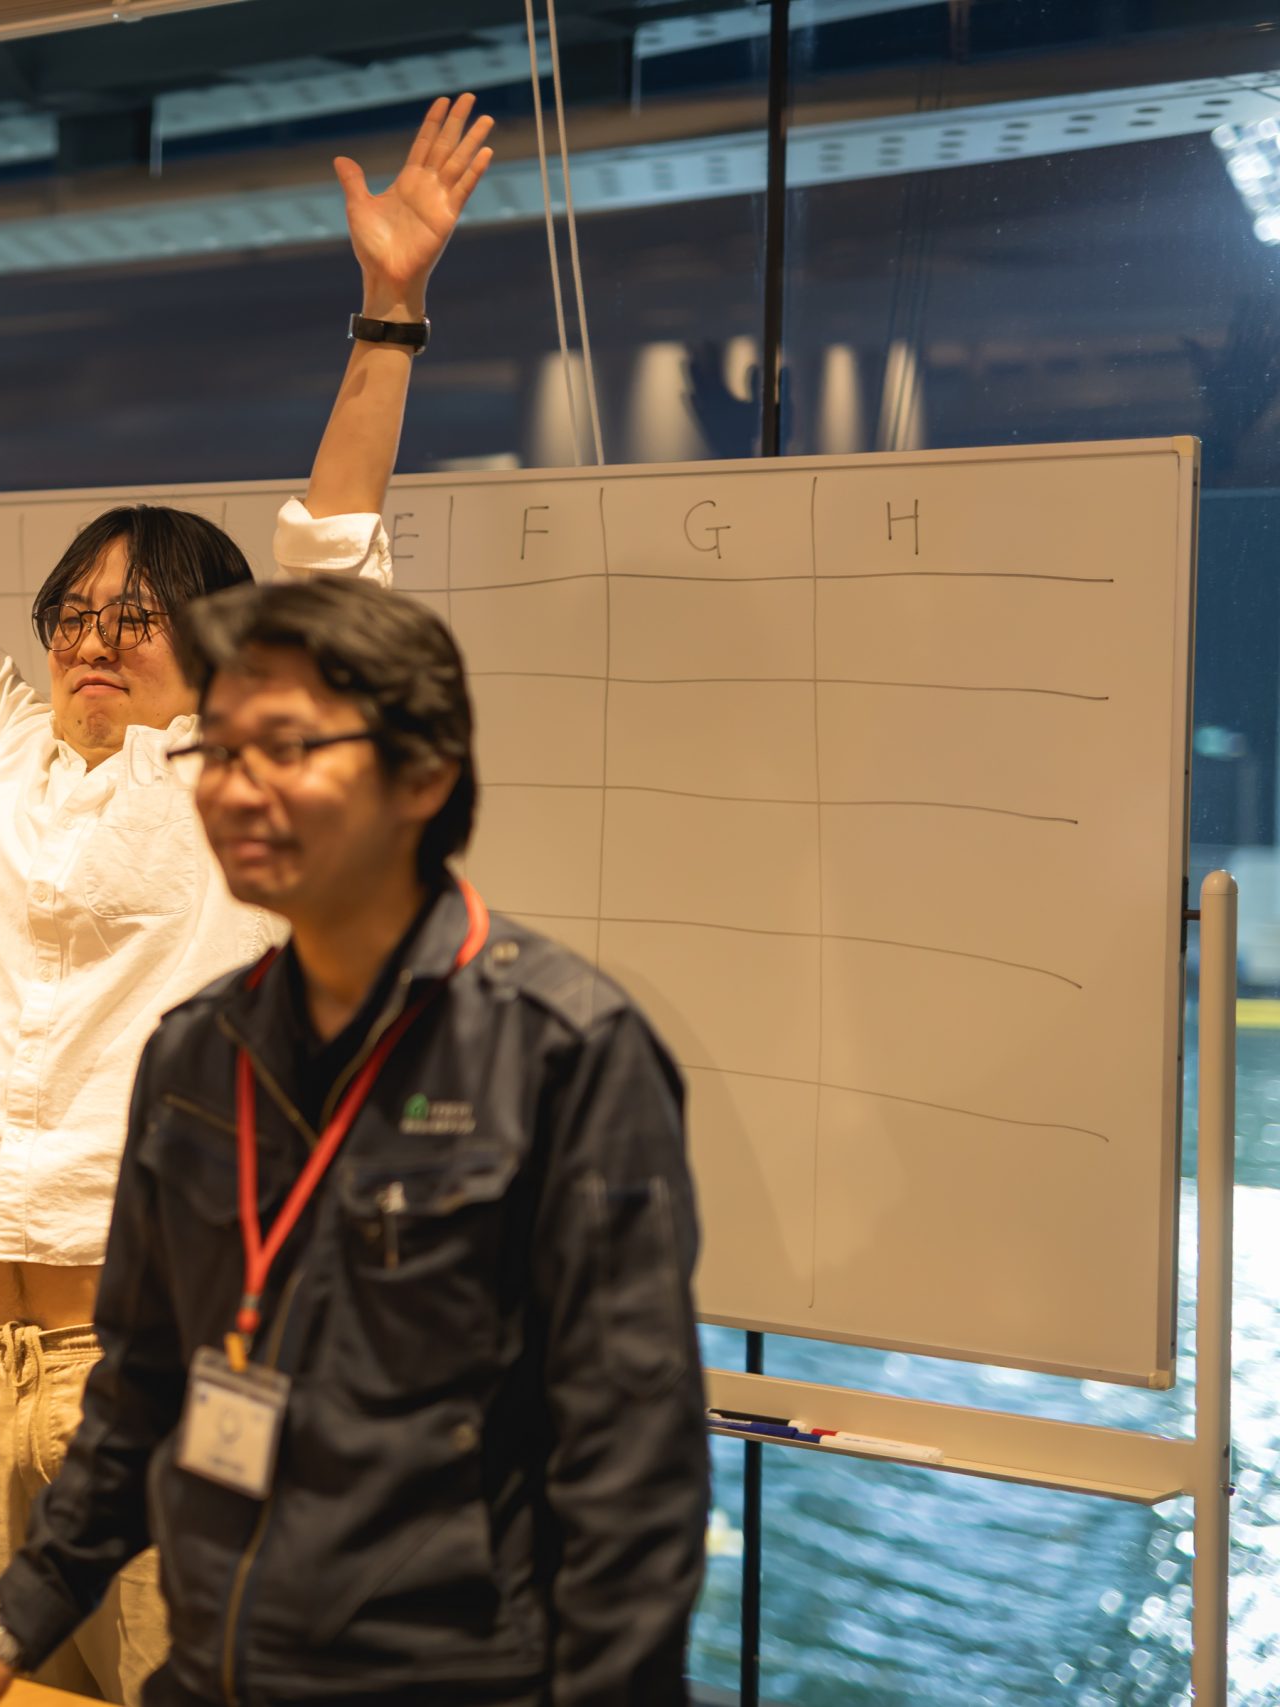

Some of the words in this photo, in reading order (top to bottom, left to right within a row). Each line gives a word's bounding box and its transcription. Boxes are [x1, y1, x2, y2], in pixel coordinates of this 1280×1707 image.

[392, 512, 420, 563] E
[520, 505, 550, 561] F
[683, 499, 732, 560] G
[885, 498, 920, 556] H
